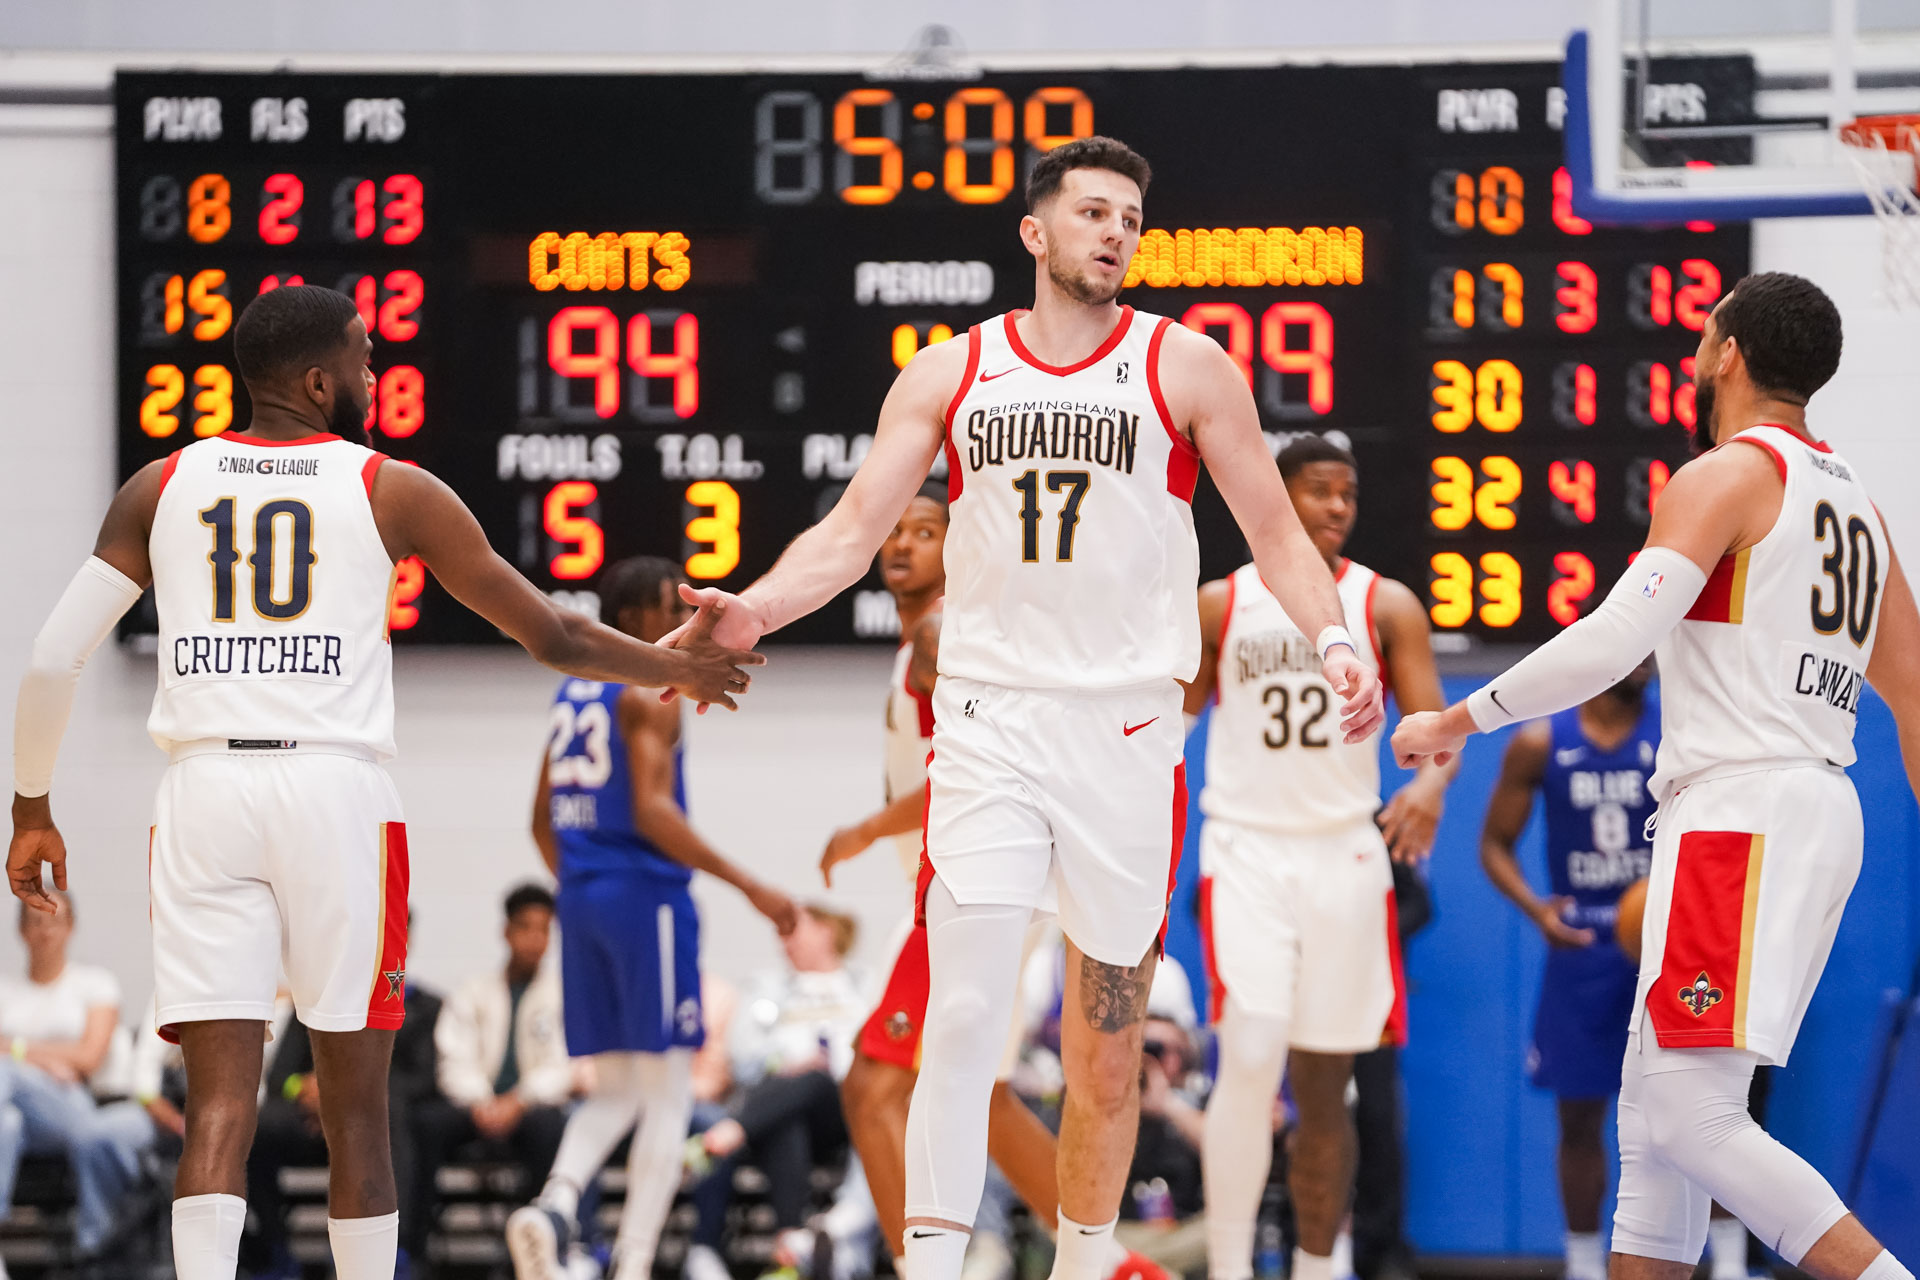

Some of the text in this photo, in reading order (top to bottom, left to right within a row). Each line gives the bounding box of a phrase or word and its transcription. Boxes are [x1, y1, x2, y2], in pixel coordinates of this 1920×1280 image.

[250, 96, 309, 142] FLS
[343, 96, 406, 142] PTS
[187, 173, 424, 245] 8 2 13
[1454, 166, 1525, 236] 10
[164, 268, 425, 342] 15 12
[854, 260, 995, 306] PERIOD
[1452, 258, 1722, 334] 17 3 12
[547, 305, 700, 419] 94
[1431, 359, 1524, 434] 30
[1574, 363, 1597, 426] 1
[139, 363, 234, 438] 23
[989, 400, 1117, 418] BIRMINGHAM
[229, 457, 255, 475] NBA
[276, 459, 320, 477] LEAGUE
[497, 433, 623, 481] FOULS
[968, 409, 1140, 475] SQUADRON
[543, 480, 741, 580] 5 3
[1012, 469, 1091, 562] 17
[1430, 455, 1523, 531] 32
[1547, 460, 1597, 524] 4
[198, 496, 318, 623] 10
[1430, 551, 1523, 629] 33
[1811, 499, 1878, 649] 30
[174, 634, 342, 678] CRUTCHER
[549, 701, 612, 788] 23
[1262, 685, 1329, 750] 32
[1570, 769, 1645, 809] BLUE
